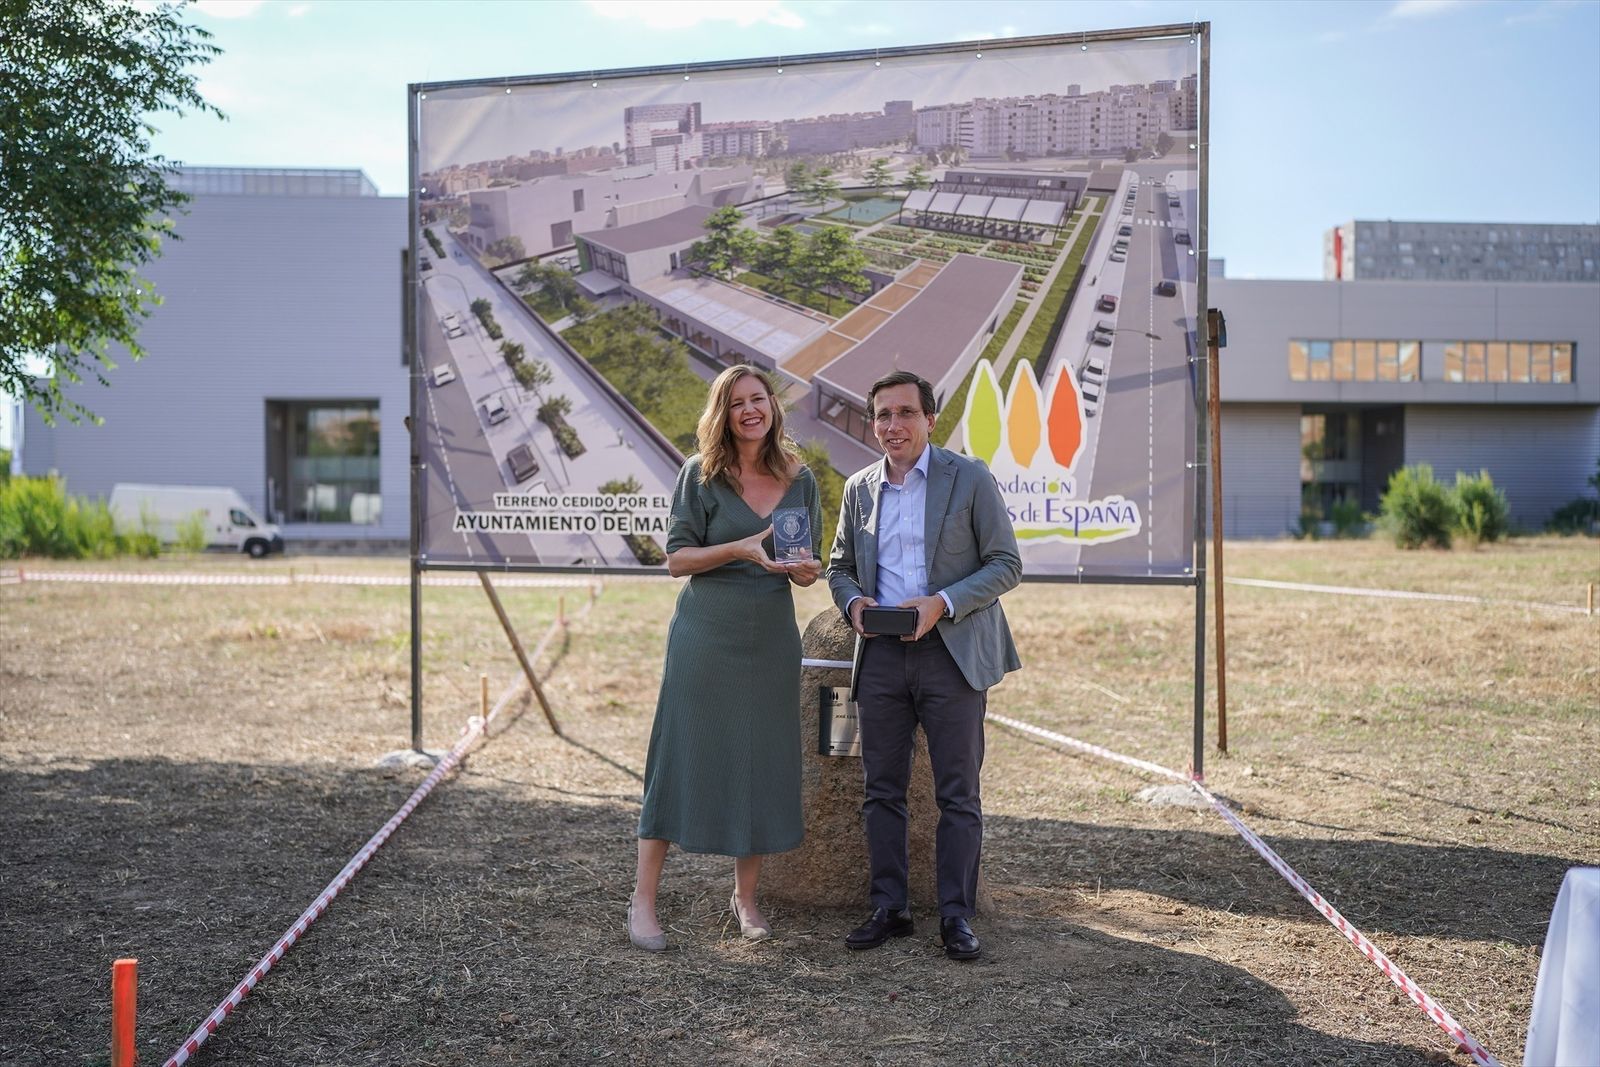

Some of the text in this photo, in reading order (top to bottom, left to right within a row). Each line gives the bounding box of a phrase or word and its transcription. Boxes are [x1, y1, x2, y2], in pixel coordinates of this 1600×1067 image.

[998, 474, 1071, 494] ndación
[496, 495, 668, 508] TERRENO CEDIDO POR EL
[456, 514, 669, 532] AYUNTAMIENTO DE MA
